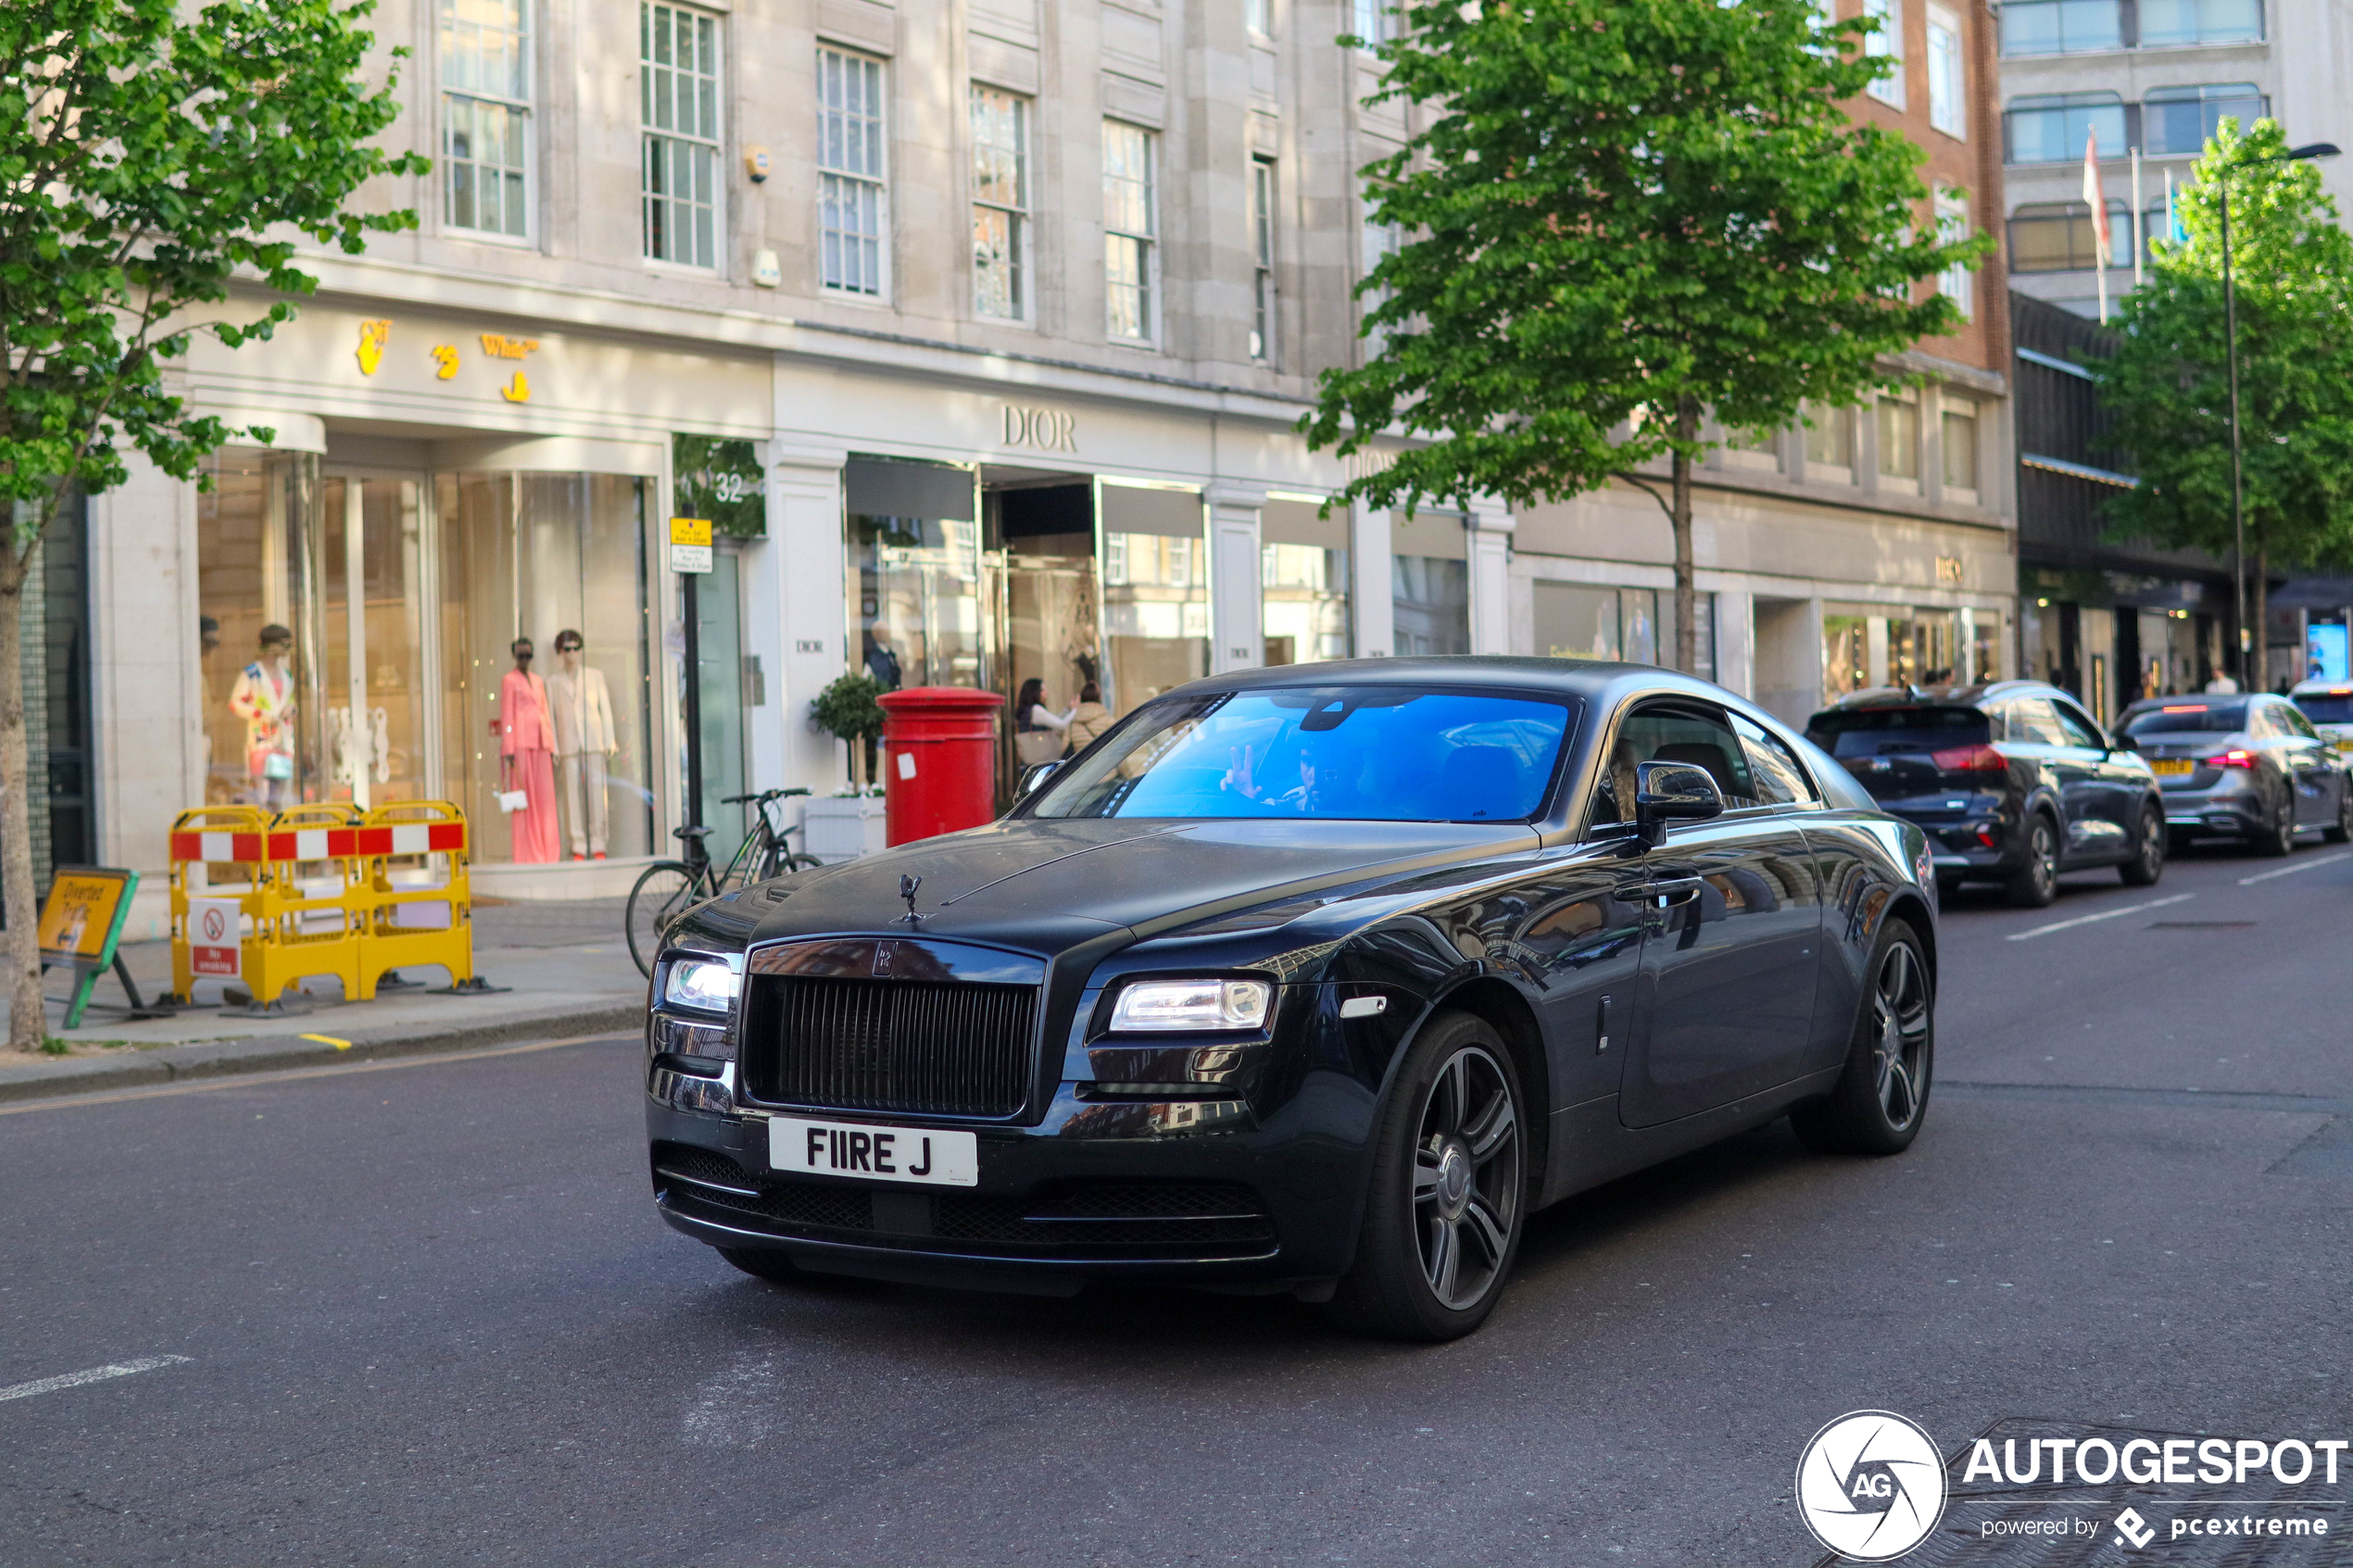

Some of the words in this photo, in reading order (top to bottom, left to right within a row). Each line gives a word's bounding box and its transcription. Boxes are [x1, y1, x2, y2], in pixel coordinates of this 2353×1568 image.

[1000, 405, 1078, 454] DIOR
[716, 471, 743, 503] 32
[797, 639, 824, 655] DIOR
[62, 881, 105, 902] Diverted
[62, 901, 91, 922] Traffic
[208, 948, 221, 960] No
[198, 960, 232, 972] smoking
[909, 1136, 931, 1175] J
